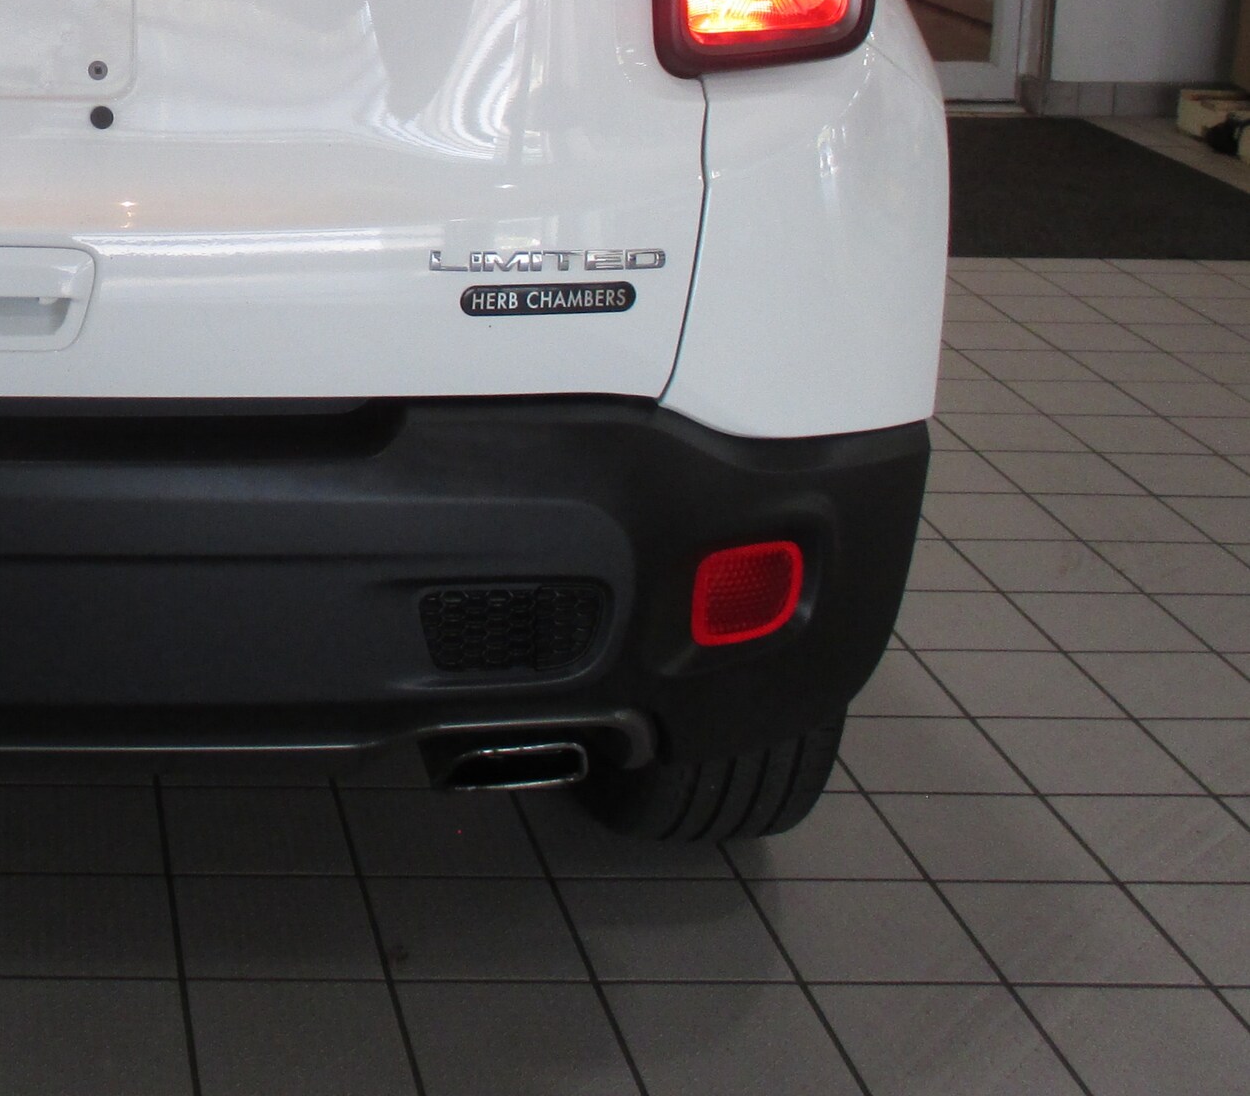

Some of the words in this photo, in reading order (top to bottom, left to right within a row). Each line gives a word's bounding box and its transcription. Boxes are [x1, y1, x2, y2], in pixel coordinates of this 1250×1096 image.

[429, 249, 666, 272] LIMITED
[471, 292, 518, 310] HERB
[526, 288, 626, 309] CHAMBERS
